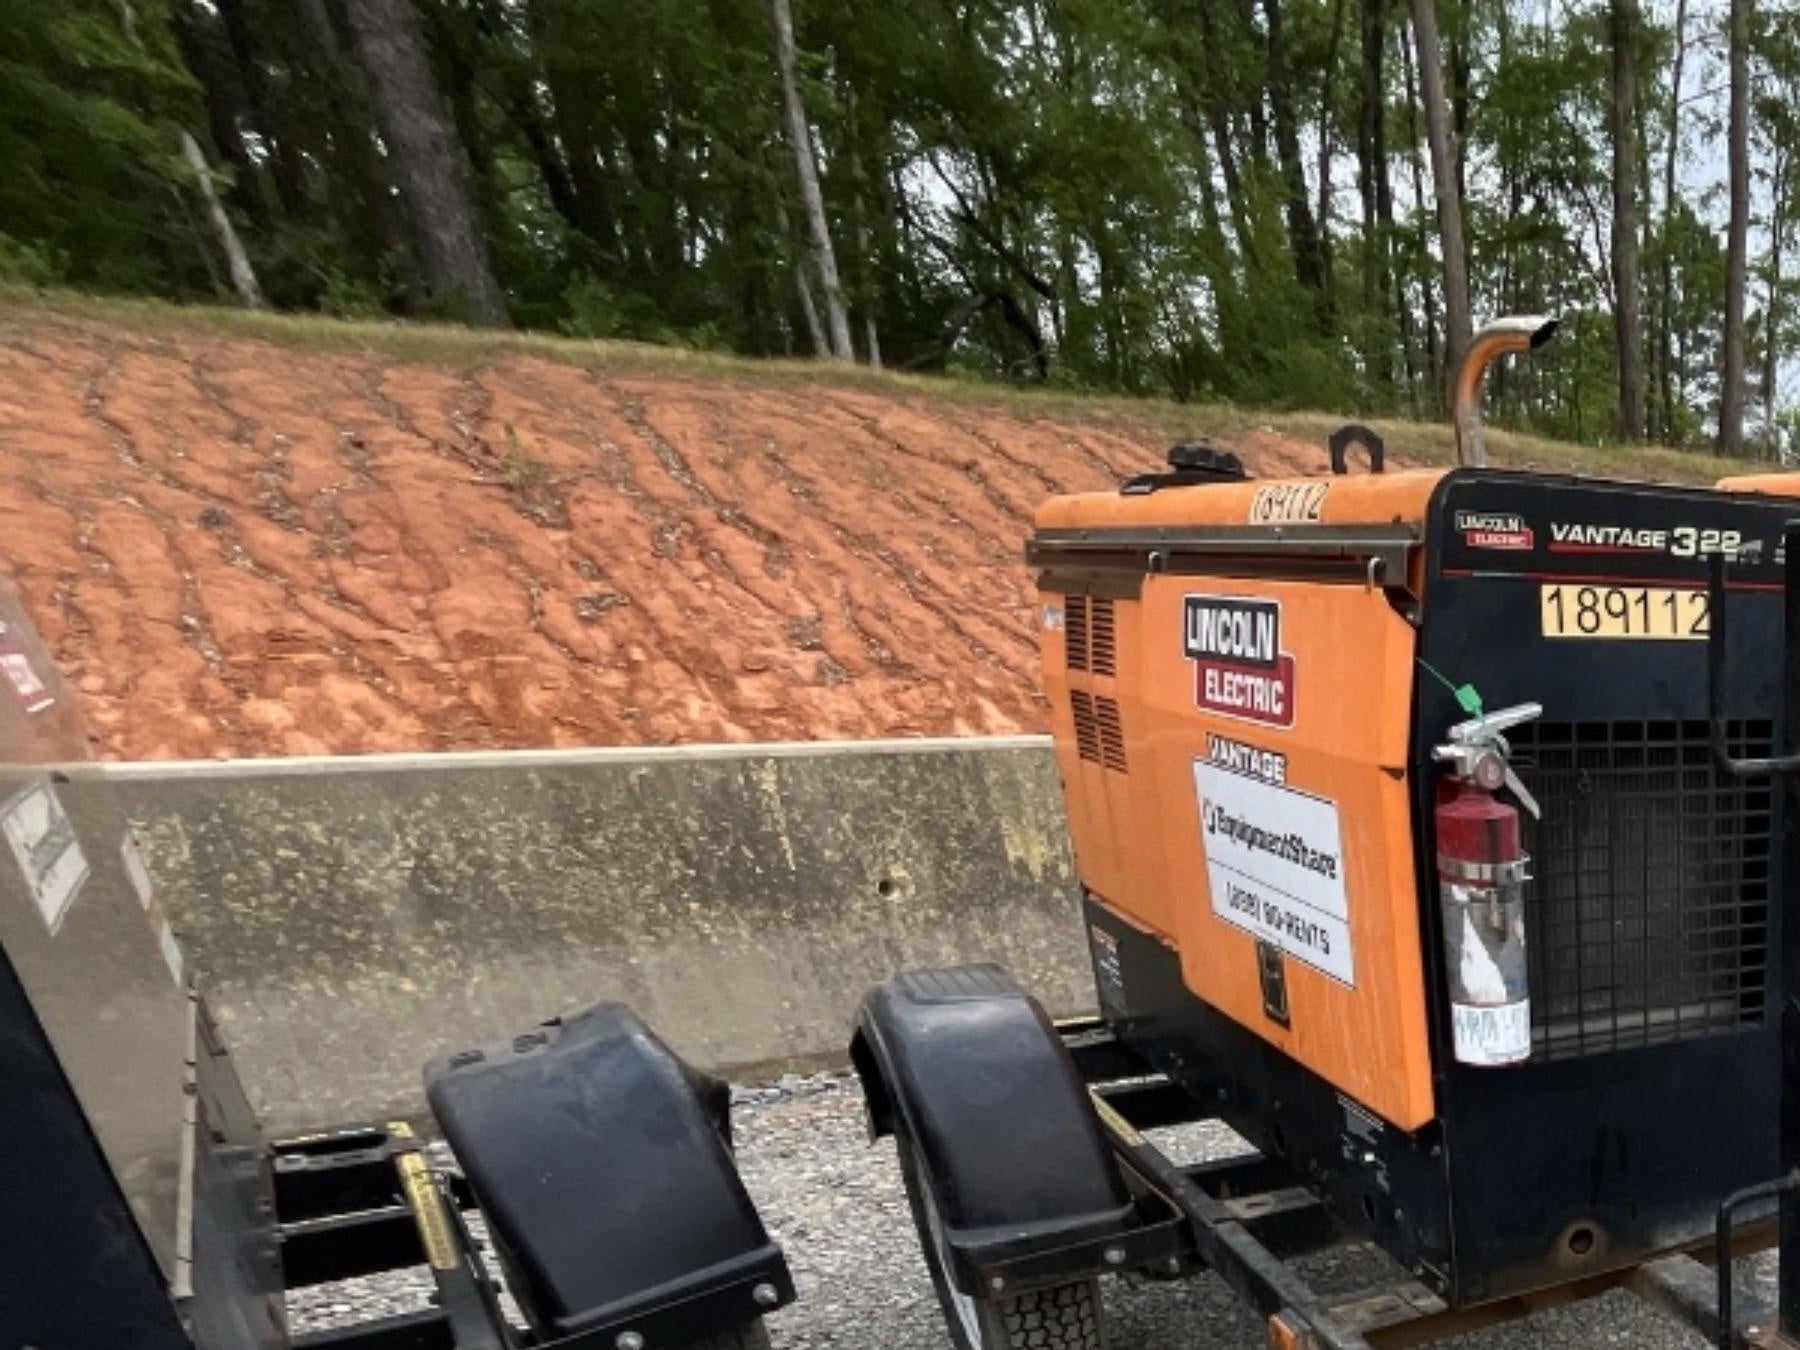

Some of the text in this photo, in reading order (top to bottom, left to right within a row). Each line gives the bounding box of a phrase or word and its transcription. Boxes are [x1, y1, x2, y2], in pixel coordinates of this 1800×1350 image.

[1459, 515, 1520, 532] LINCOLN
[1551, 522, 1667, 549] VANTAGE
[1187, 604, 1275, 662] LINCOLN
[1547, 586, 1711, 634] 189112
[1205, 667, 1285, 715] ELECTRIC
[1205, 731, 1288, 785] VANTAGE
